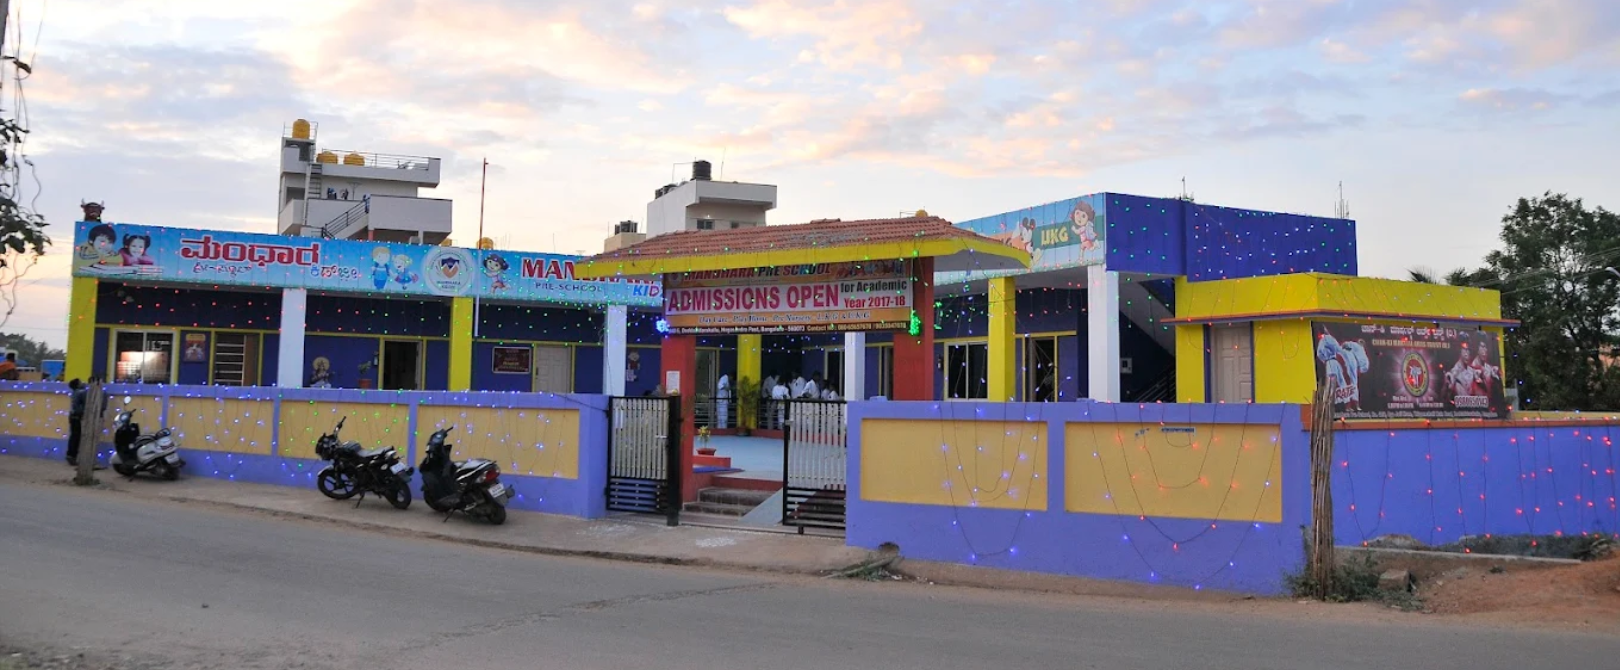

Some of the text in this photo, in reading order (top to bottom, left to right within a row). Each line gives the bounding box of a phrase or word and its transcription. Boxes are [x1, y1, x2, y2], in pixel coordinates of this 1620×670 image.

[1041, 226, 1069, 246] UKG
[782, 263, 831, 276] SCHOOL
[535, 282, 603, 292] PRE-SCHOOL
[841, 280, 908, 293] for Academic
[668, 284, 839, 311] ADMISSIONS OPEN
[844, 295, 906, 308] Year 2017-18
